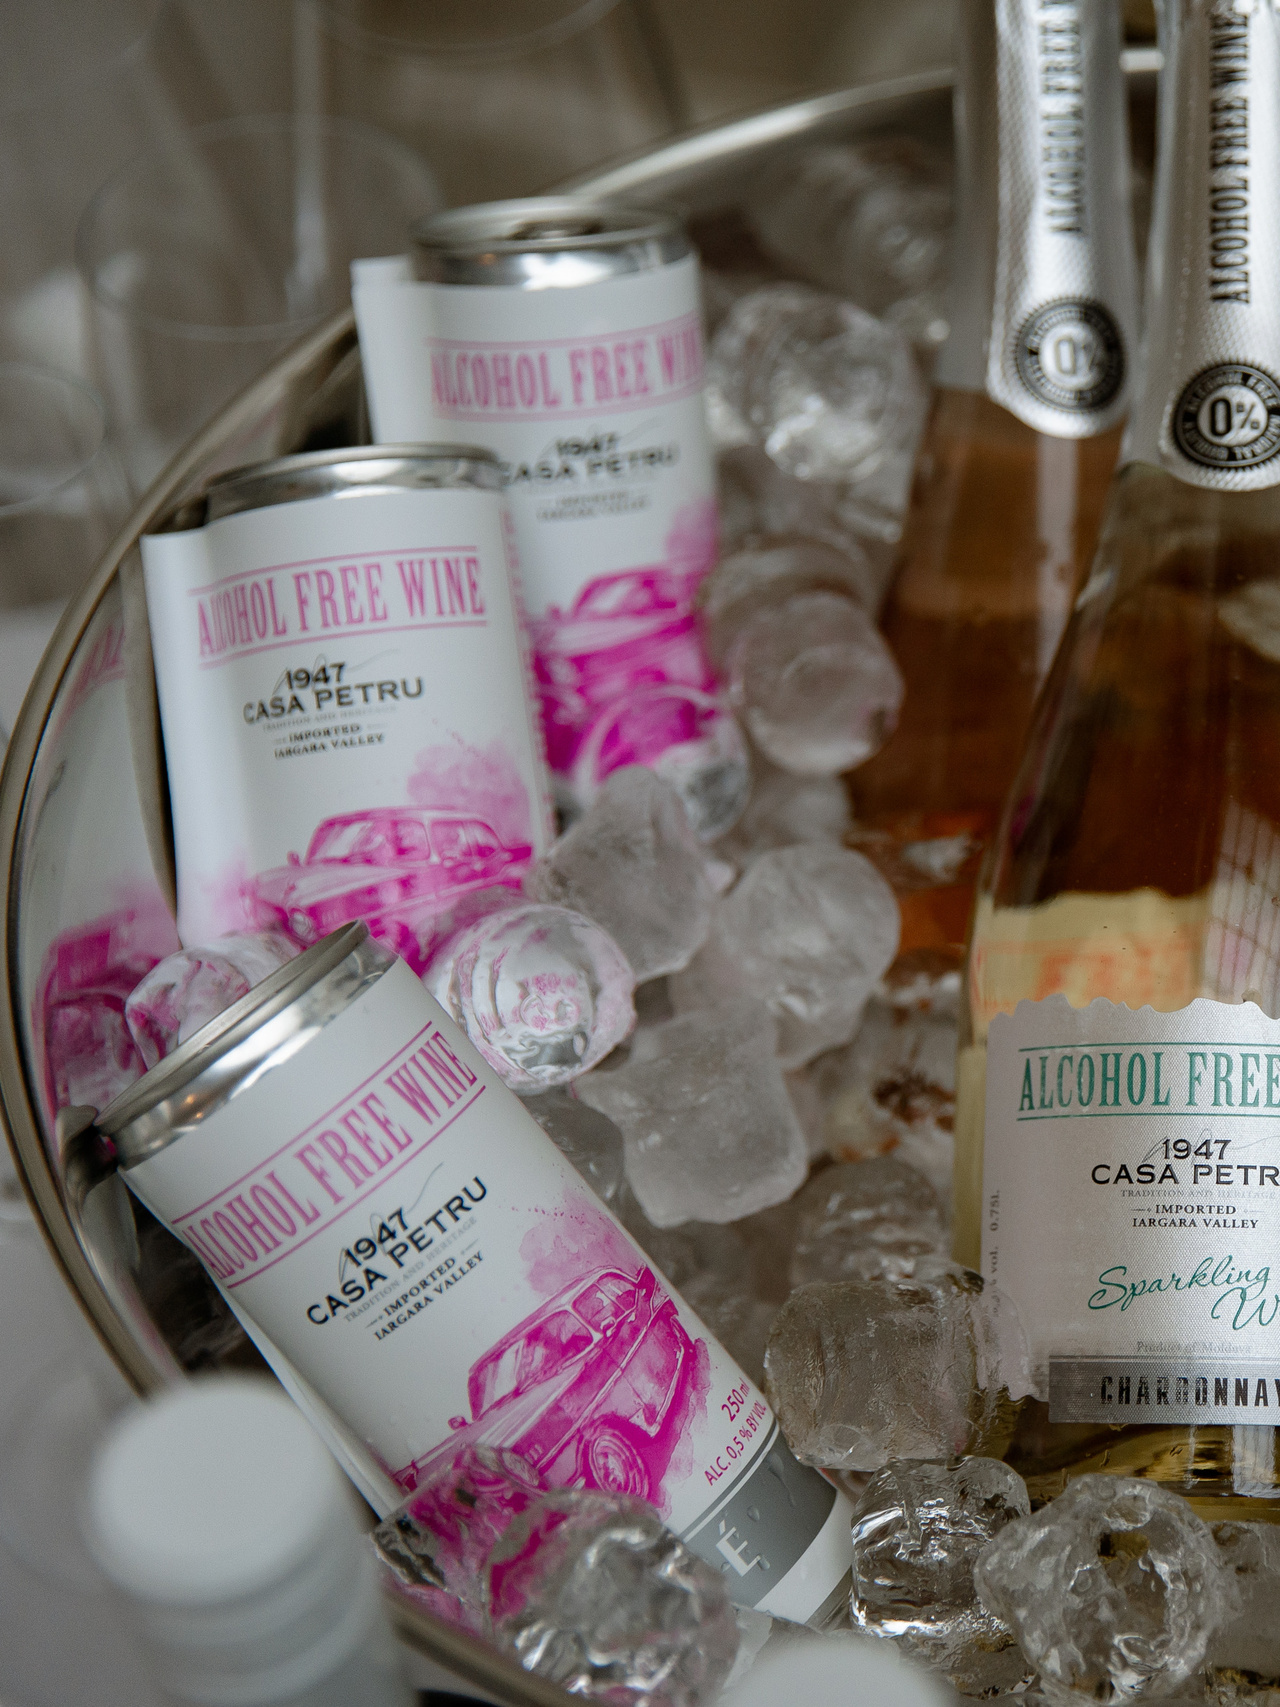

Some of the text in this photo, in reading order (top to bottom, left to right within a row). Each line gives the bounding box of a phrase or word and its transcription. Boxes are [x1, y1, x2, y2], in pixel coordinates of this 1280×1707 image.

[1208, 13, 1249, 303] ALCOHOL FREE WINE
[568, 339, 652, 404] FREE
[655, 328, 702, 388] WIN
[1210, 398, 1260, 437] 0%
[293, 562, 389, 632] FREE
[396, 556, 486, 618] WINE
[243, 694, 304, 725] CASA
[314, 676, 424, 710] PETRU
[286, 661, 346, 690] 1947
[1018, 1052, 1171, 1111] ALCOHOL
[293, 1092, 414, 1205] FREE
[384, 1031, 478, 1126] WINE
[1091, 1164, 1180, 1185] CASA
[1162, 1138, 1232, 1160] 1947
[1120, 1189, 1184, 1198] TRADITION
[1155, 1205, 1237, 1215] IMPORTED
[306, 1176, 488, 1325] CASA PETRU
[344, 1207, 409, 1268] 1947
[1133, 1218, 1259, 1229] IARGARA VALLEY
[344, 1280, 400, 1322] TRADITION
[373, 1250, 484, 1341] IARGARA VALLEY
[383, 1257, 456, 1316] IMPORTED
[1087, 1254, 1272, 1312] Sparkling
[721, 1388, 745, 1422] 250
[704, 1456, 732, 1486] ALC.
[726, 1436, 745, 1461] 0,5
[739, 1426, 752, 1442] %
[746, 1414, 760, 1436] BY
